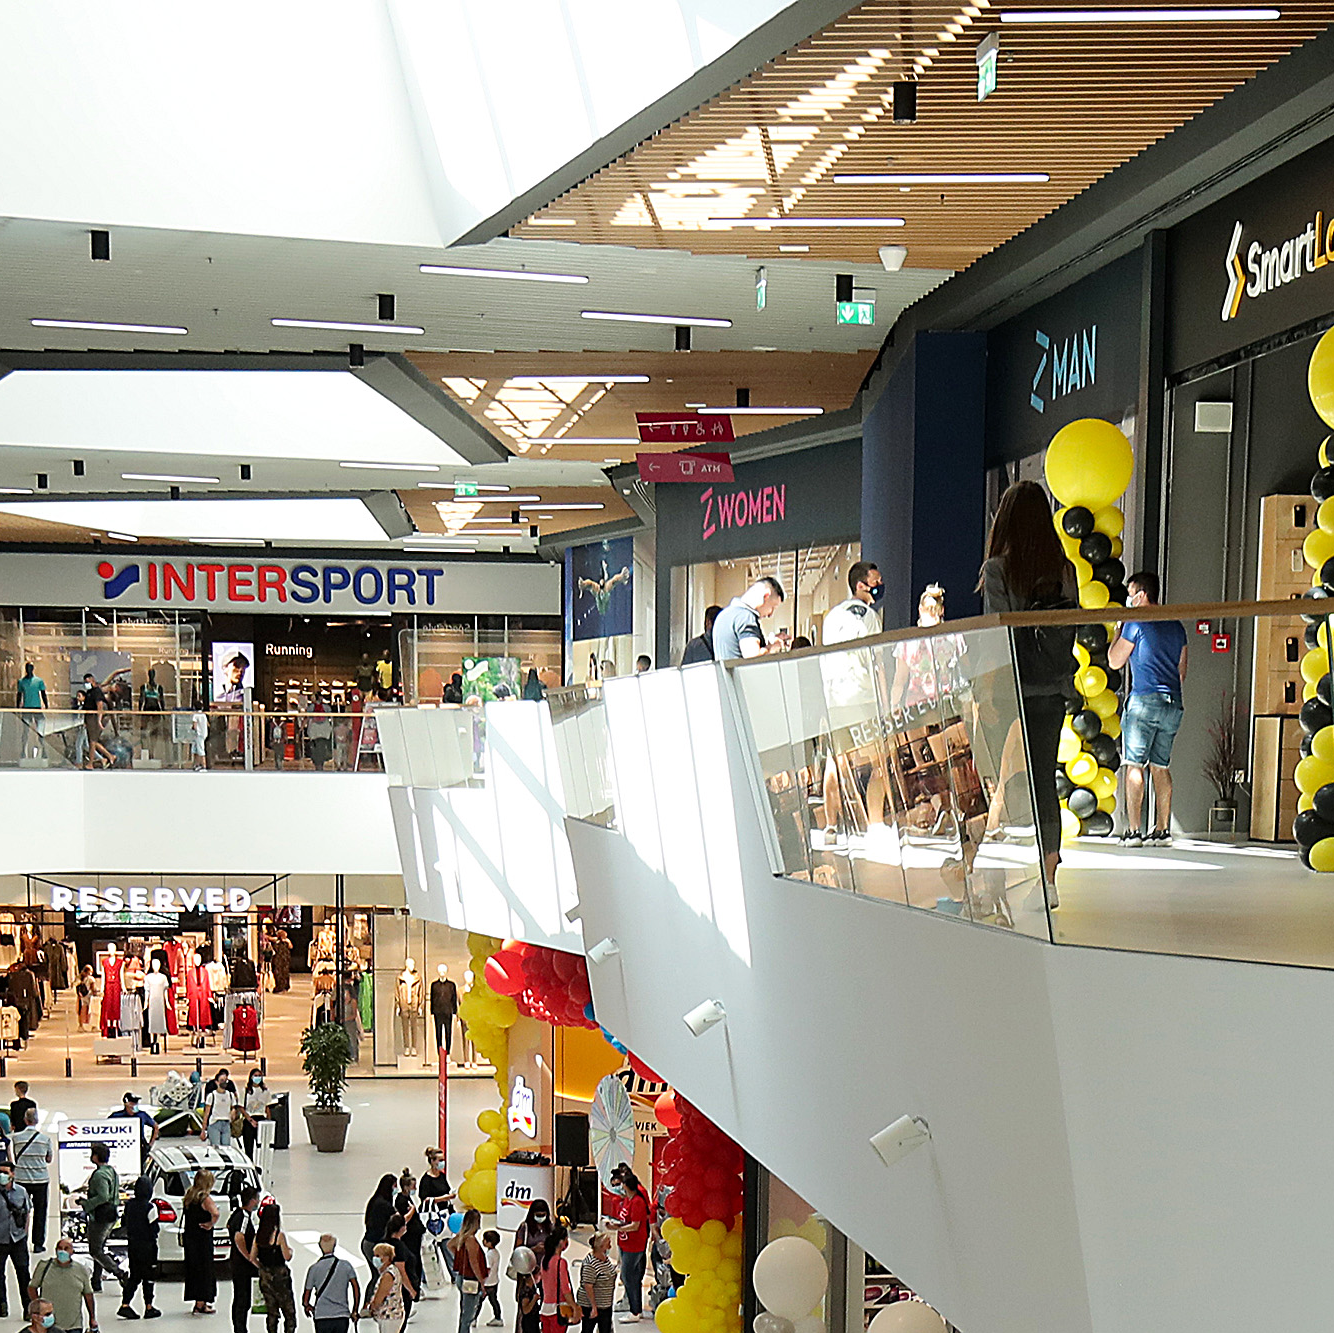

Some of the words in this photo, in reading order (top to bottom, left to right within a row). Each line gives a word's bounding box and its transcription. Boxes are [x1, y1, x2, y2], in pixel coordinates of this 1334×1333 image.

[1053, 325, 1096, 400] MAN
[701, 464, 721, 473] ATM
[718, 484, 786, 530] WOMEN
[149, 562, 444, 605] INTERSPORT
[266, 644, 313, 659] Running
[50, 887, 252, 912] RESERVED
[82, 1126, 131, 1134] SUZUKI
[505, 1180, 532, 1199] dm
